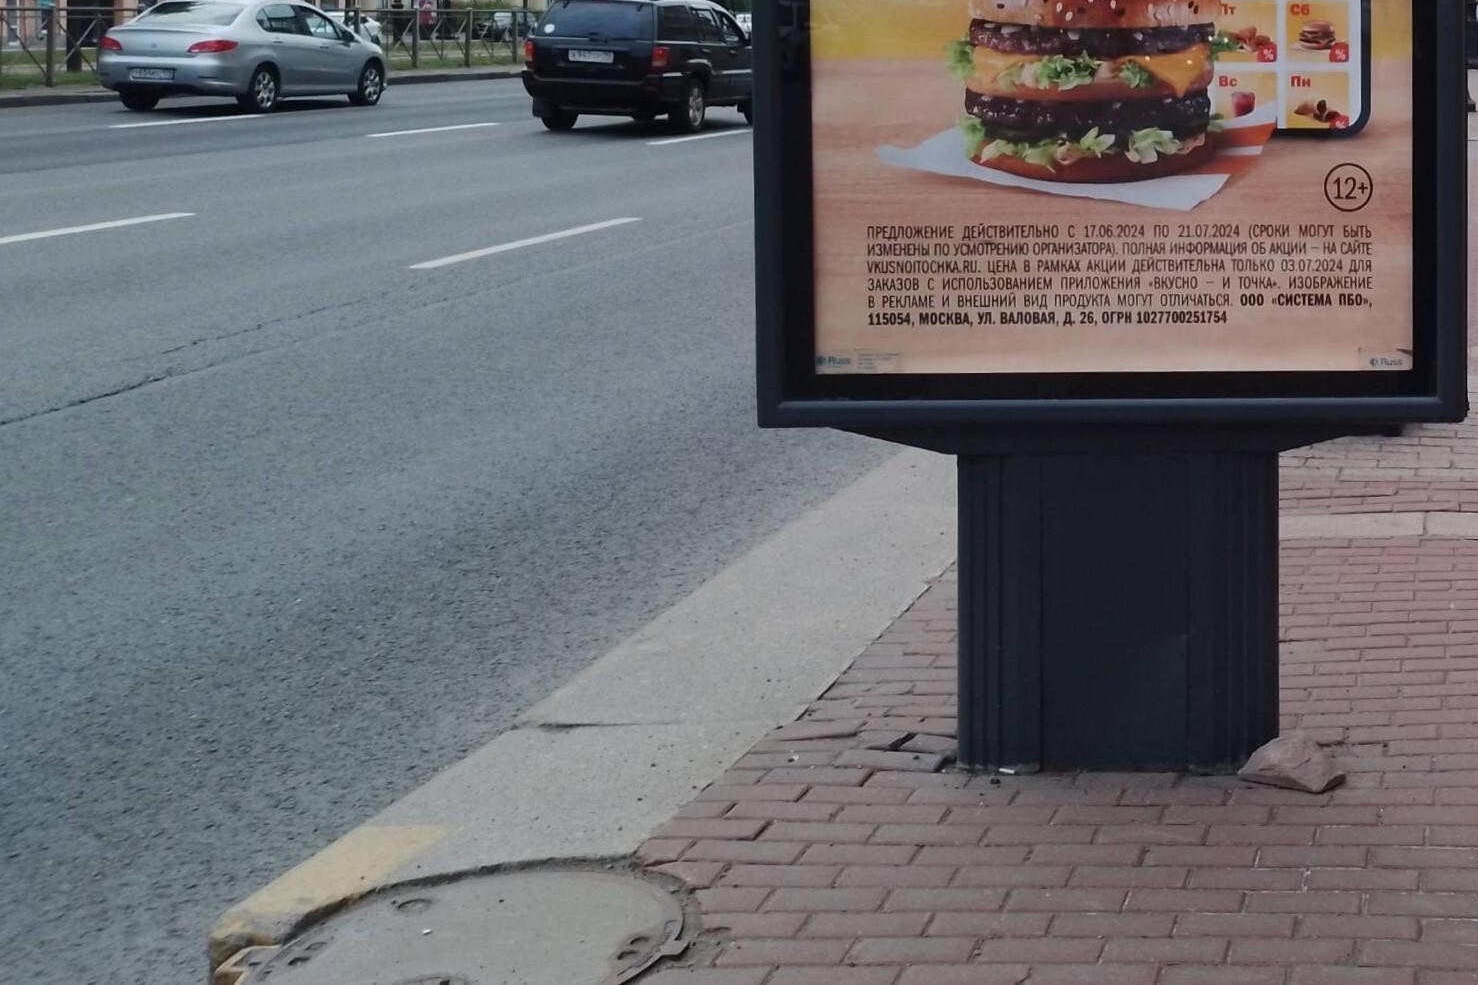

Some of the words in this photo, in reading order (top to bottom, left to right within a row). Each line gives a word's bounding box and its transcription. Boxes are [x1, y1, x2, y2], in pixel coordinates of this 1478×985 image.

[1290, 4, 1310, 16] Сб
[1263, 49, 1274, 60] %
[1335, 49, 1346, 60] %
[1218, 76, 1237, 87] Вс
[1291, 76, 1311, 87] Пн
[1333, 176, 1368, 200] 12+
[867, 225, 954, 241] ПРЕДЛОЖЕНИЕ
[962, 223, 1059, 241] ДЕЙСТВИТЕЛЬНО
[1068, 225, 1075, 238] С
[1084, 224, 1145, 238] 17.06.2024
[1153, 224, 1170, 238] ПО
[1178, 224, 1240, 238] 21.07.2024
[1248, 224, 1290, 240] (СРОКИ
[1300, 224, 1335, 238] МОГУТ
[1343, 224, 1372, 238] БЫТЬ
[867, 243, 930, 257] ИЗМЕНЕНЫ
[934, 243, 950, 256] ПО
[954, 242, 1029, 257] УСМОТРЕНИЮ
[1122, 242, 1166, 256] ПОЛНАЯ
[1170, 241, 1247, 257] ИНФОРМАЦИЯ
[1252, 242, 1266, 255] ОБ
[1269, 242, 1306, 257] АКЦИИ
[1323, 242, 1337, 255] НА
[1340, 240, 1372, 255] САЙТЕ
[867, 260, 981, 274] VKUSNOITOCHKA.RU.
[988, 260, 1017, 275] ЦЕНА
[1024, 260, 1031, 272] В
[1037, 260, 1081, 272] РАМКАХ
[1086, 259, 1126, 275] АКЦИИ
[1132, 257, 1226, 275] ДЕЙСТВИТЕЛЬНА
[1232, 259, 1275, 272] ТОЛЬКО
[1280, 258, 1343, 272] 03.07.2024
[1348, 259, 1372, 274] ДЛЯ
[867, 278, 920, 291] ЗАКАЗОВ
[927, 277, 935, 290] С
[942, 277, 1052, 290] ИСПОЛЬЗОВАНИЕМ
[1060, 276, 1141, 290] ПРИЛОЖЕНИЯ
[1149, 276, 1198, 290] «ВКУСНО
[1222, 276, 1231, 289] И
[1289, 276, 1373, 289] ИЗОБРАЖЕНИЕ
[868, 295, 875, 308] В
[882, 295, 935, 308] РЕКЛАМЕ
[942, 295, 950, 307] И
[957, 292, 1017, 308] ВНЕШНИЙ
[1024, 294, 1048, 309] ВИД
[1054, 294, 1111, 309] ПРОДУКТА
[1117, 294, 1154, 306] МОГУТ
[1160, 294, 1233, 307] ОТЛИЧАТЬСЯ.
[1240, 294, 1264, 306] ООО
[1271, 294, 1332, 306] «СИСТЕМА
[868, 313, 915, 326] 115054,
[919, 312, 974, 326] МОСКВА,
[978, 312, 996, 325] УЛ.
[1000, 312, 1060, 326] ВАЛОВАЯ,
[1063, 312, 1076, 326] Д.
[1080, 311, 1098, 326] 26,
[1101, 311, 1132, 324] ОГРН
[1136, 311, 1227, 324] 1027700251754
